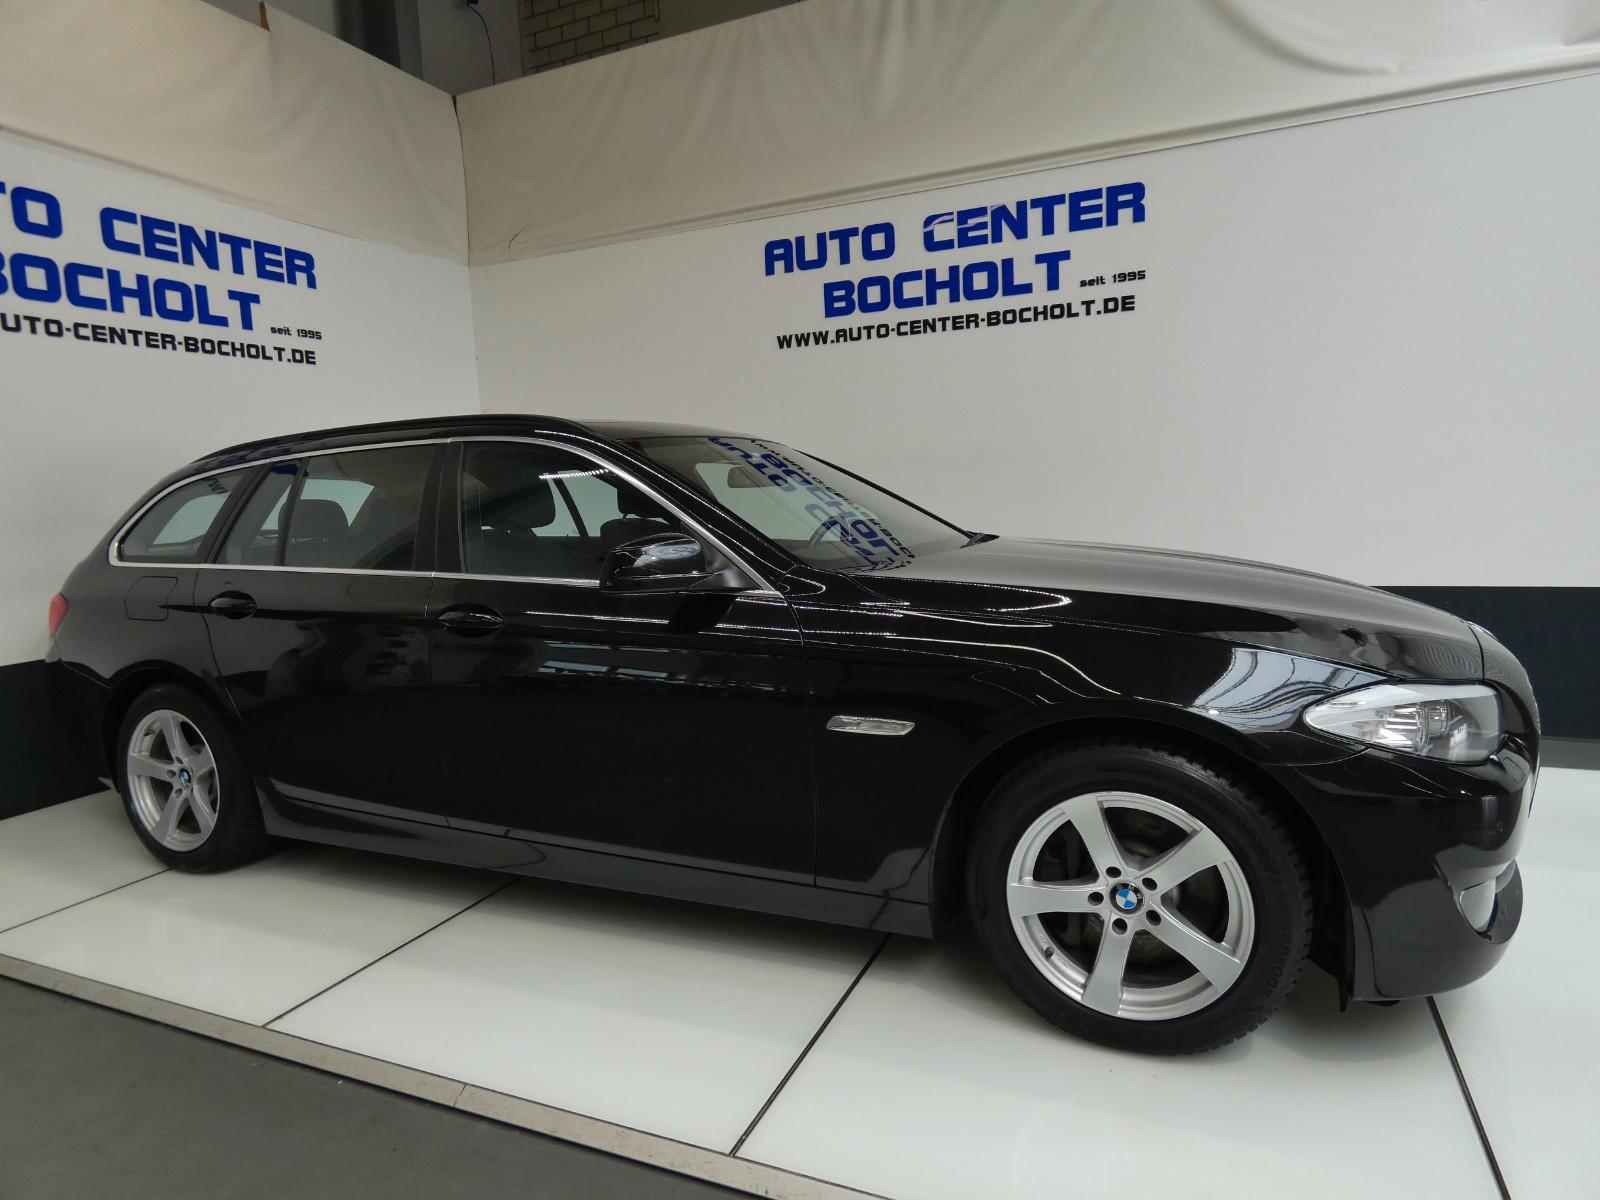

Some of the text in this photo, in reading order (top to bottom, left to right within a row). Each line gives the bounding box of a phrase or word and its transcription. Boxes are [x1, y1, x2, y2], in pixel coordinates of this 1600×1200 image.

[0, 181, 317, 290] O CENTER
[764, 181, 1146, 277] AUTO CENTER
[0, 252, 261, 331] OCHOLT
[823, 250, 1072, 318] BOCHOLT
[1080, 269, 1146, 288] seit 1995
[270, 326, 323, 340] seit 1995
